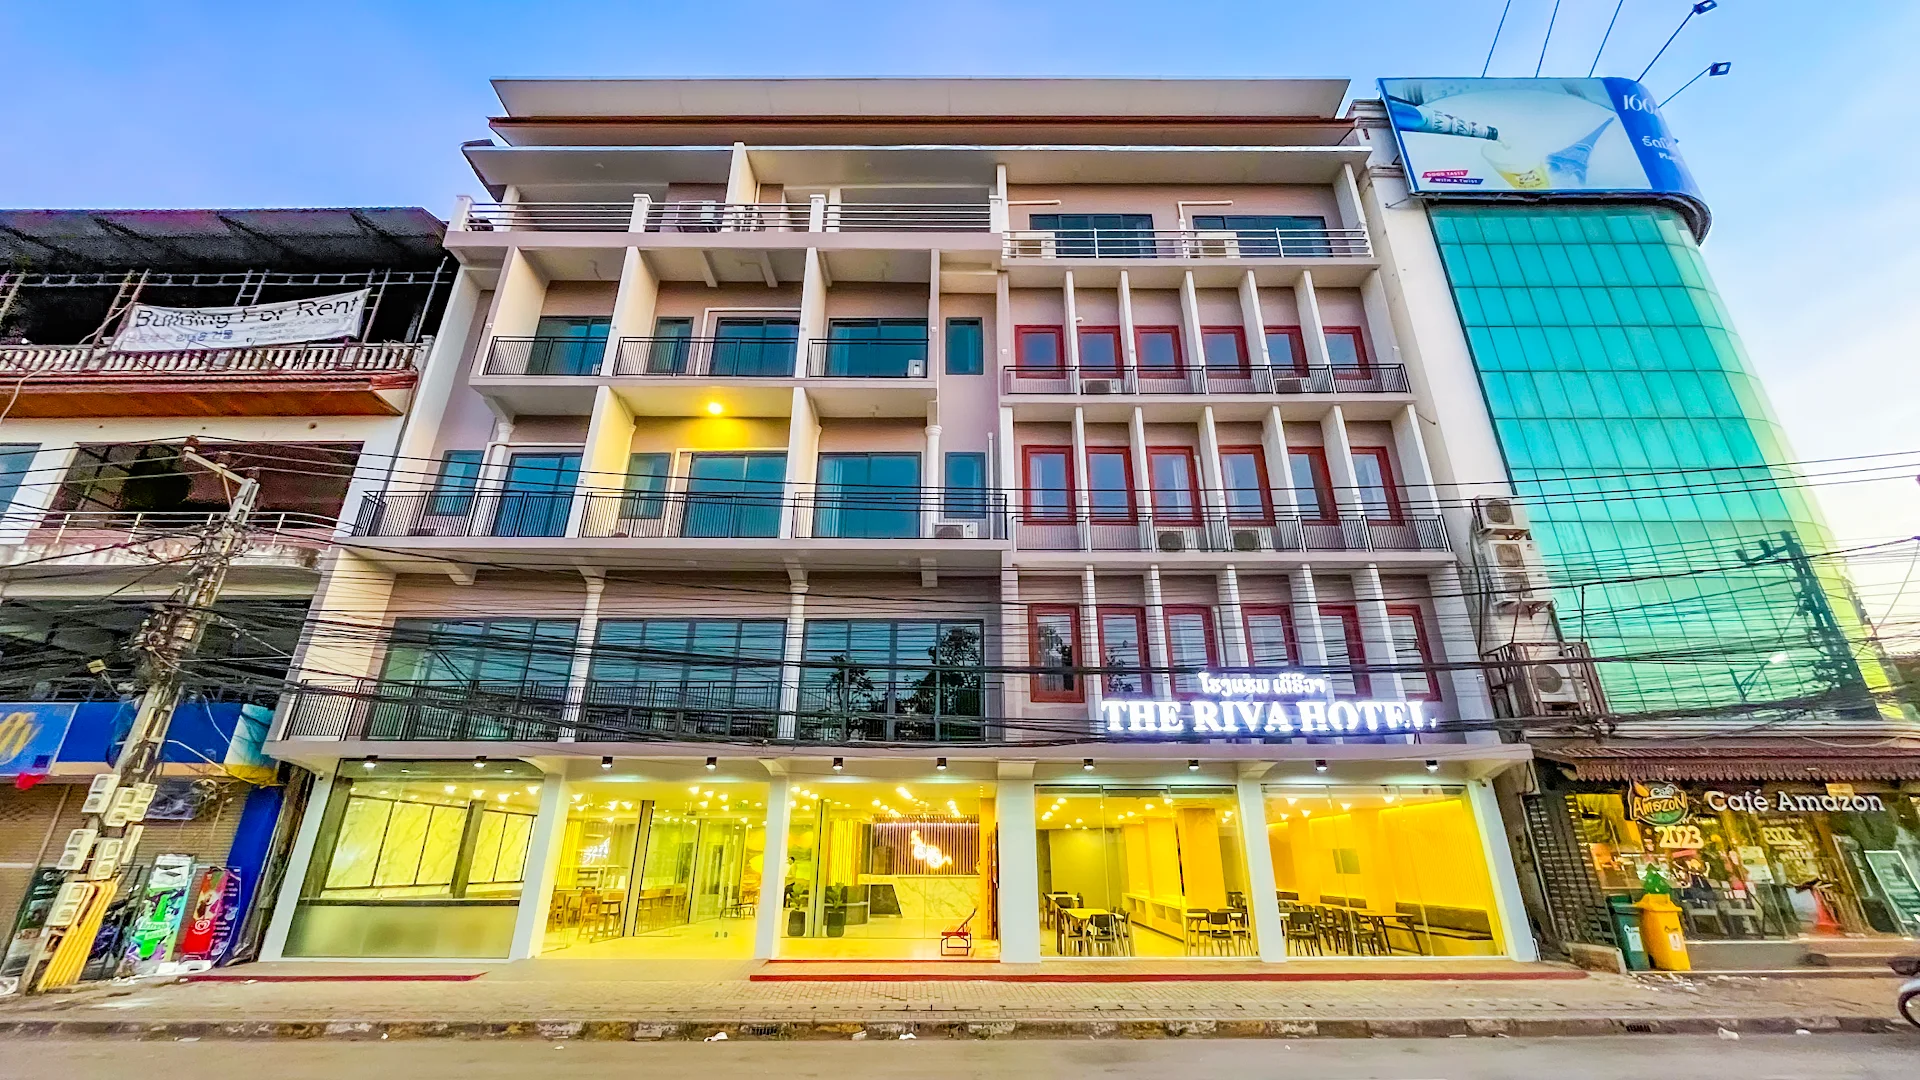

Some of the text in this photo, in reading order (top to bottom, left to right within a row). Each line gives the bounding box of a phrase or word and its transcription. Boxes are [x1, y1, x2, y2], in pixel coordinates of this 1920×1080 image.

[136, 310, 232, 328] Building
[240, 306, 288, 322] For
[296, 296, 359, 317] Rent
[1101, 700, 1437, 732] THE RIVA HOTEL
[1704, 789, 1886, 814] Café Amazon
[1654, 825, 1705, 849] 2023
